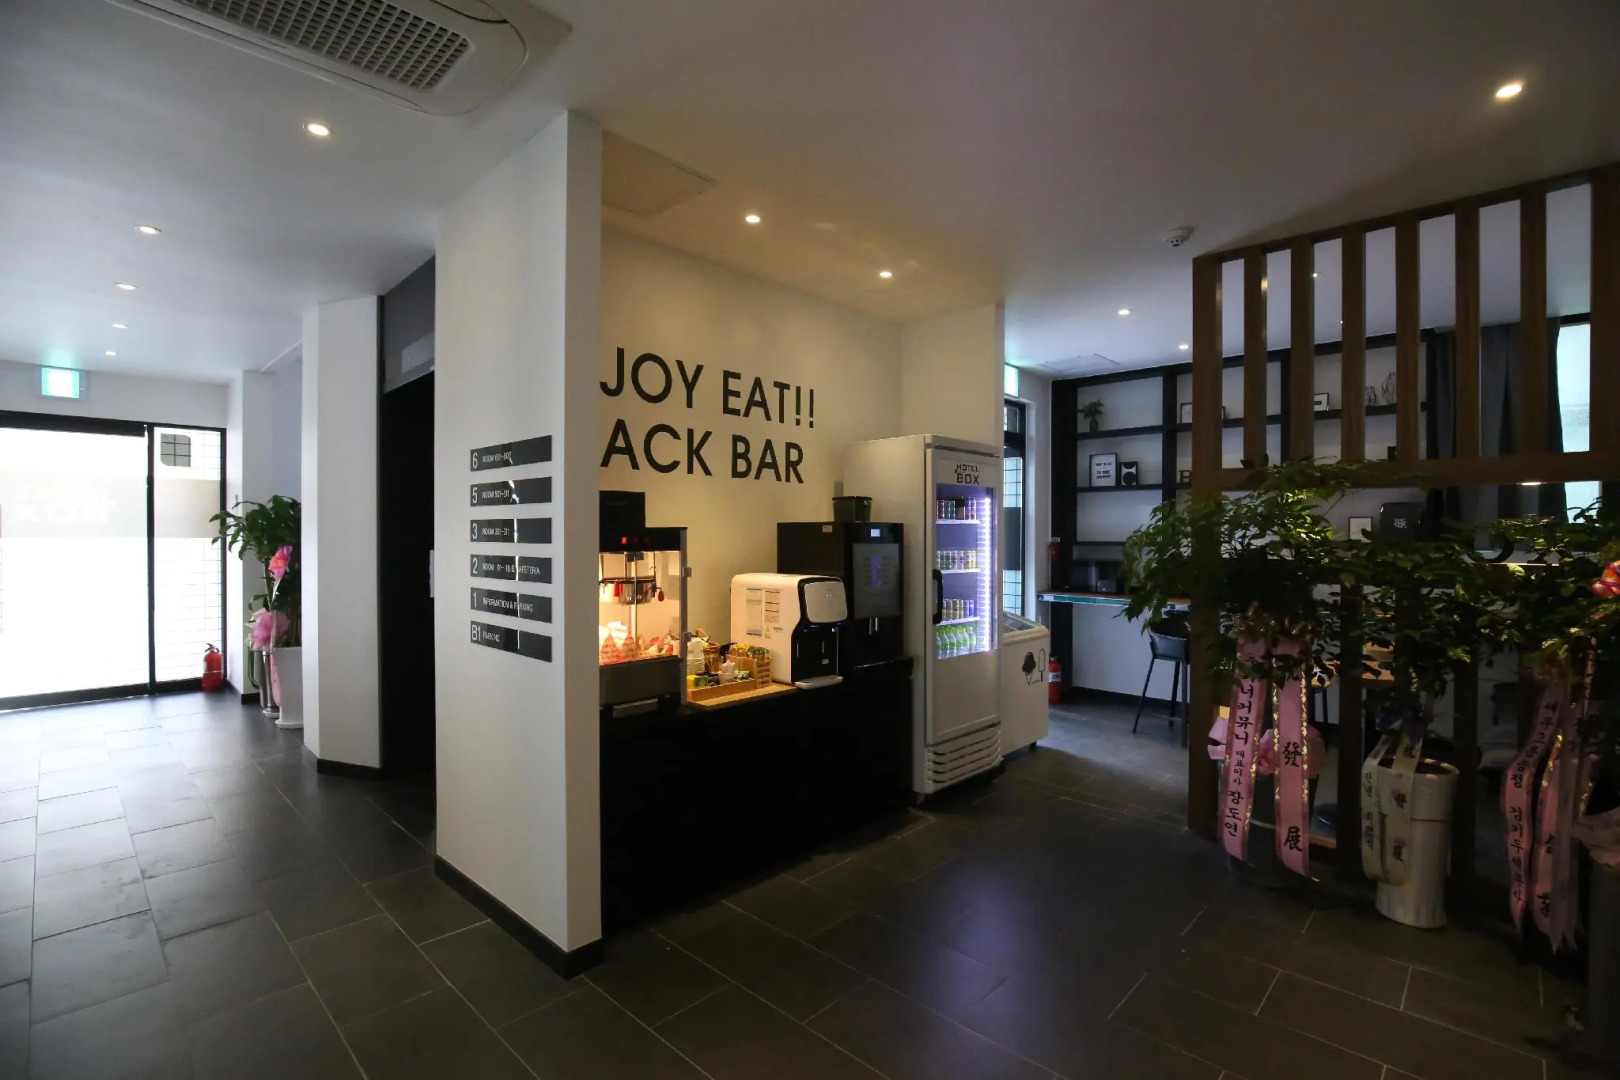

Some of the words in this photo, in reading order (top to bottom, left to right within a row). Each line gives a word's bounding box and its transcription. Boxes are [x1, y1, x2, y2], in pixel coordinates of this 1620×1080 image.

[600, 347, 704, 409] JOY
[723, 370, 814, 428] EAT!!
[600, 418, 713, 476] ACK
[732, 434, 804, 484] BAR
[472, 453, 478, 469] 6
[956, 464, 980, 473] HOTEL
[956, 473, 980, 485] BOX
[472, 487, 478, 504] 5
[472, 523, 478, 539] 3
[472, 557, 478, 574] 2
[472, 591, 478, 607] 1
[471, 624, 481, 642] B1
